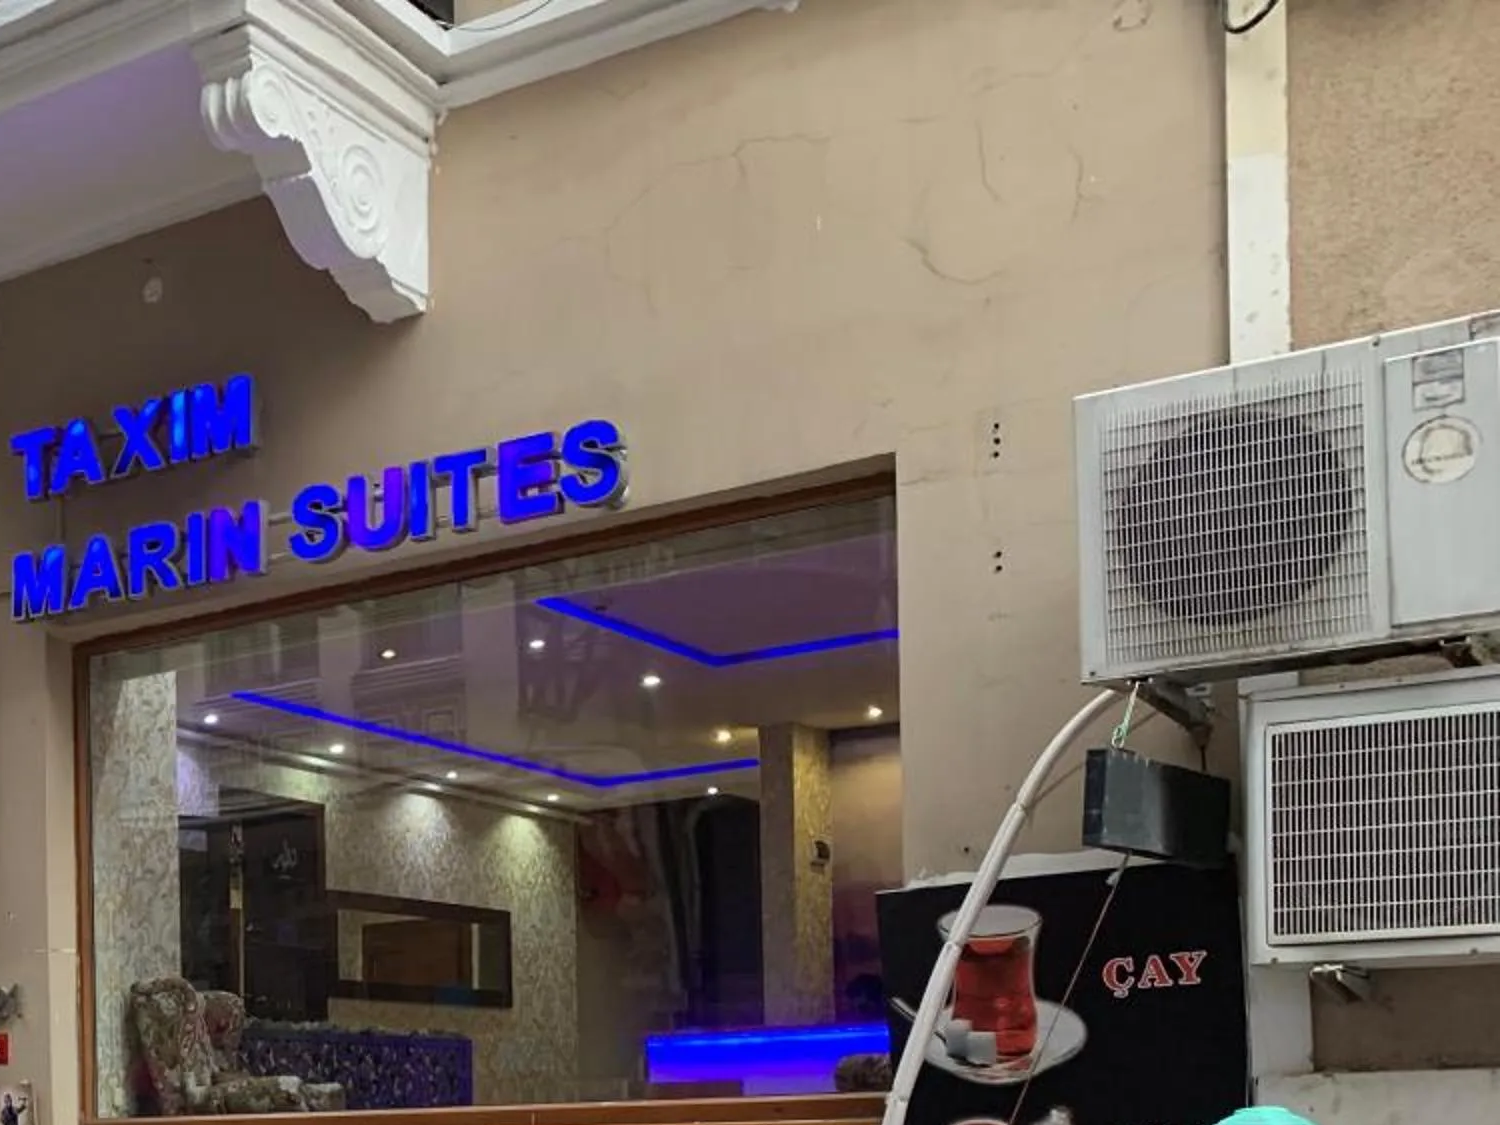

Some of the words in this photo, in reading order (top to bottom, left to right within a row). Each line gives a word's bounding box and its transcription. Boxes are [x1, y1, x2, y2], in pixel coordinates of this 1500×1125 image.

[11, 374, 256, 501] TAXIM
[11, 500, 268, 623] MARIN
[289, 419, 628, 563] SUITES
[1101, 949, 1208, 999] ÇAY
